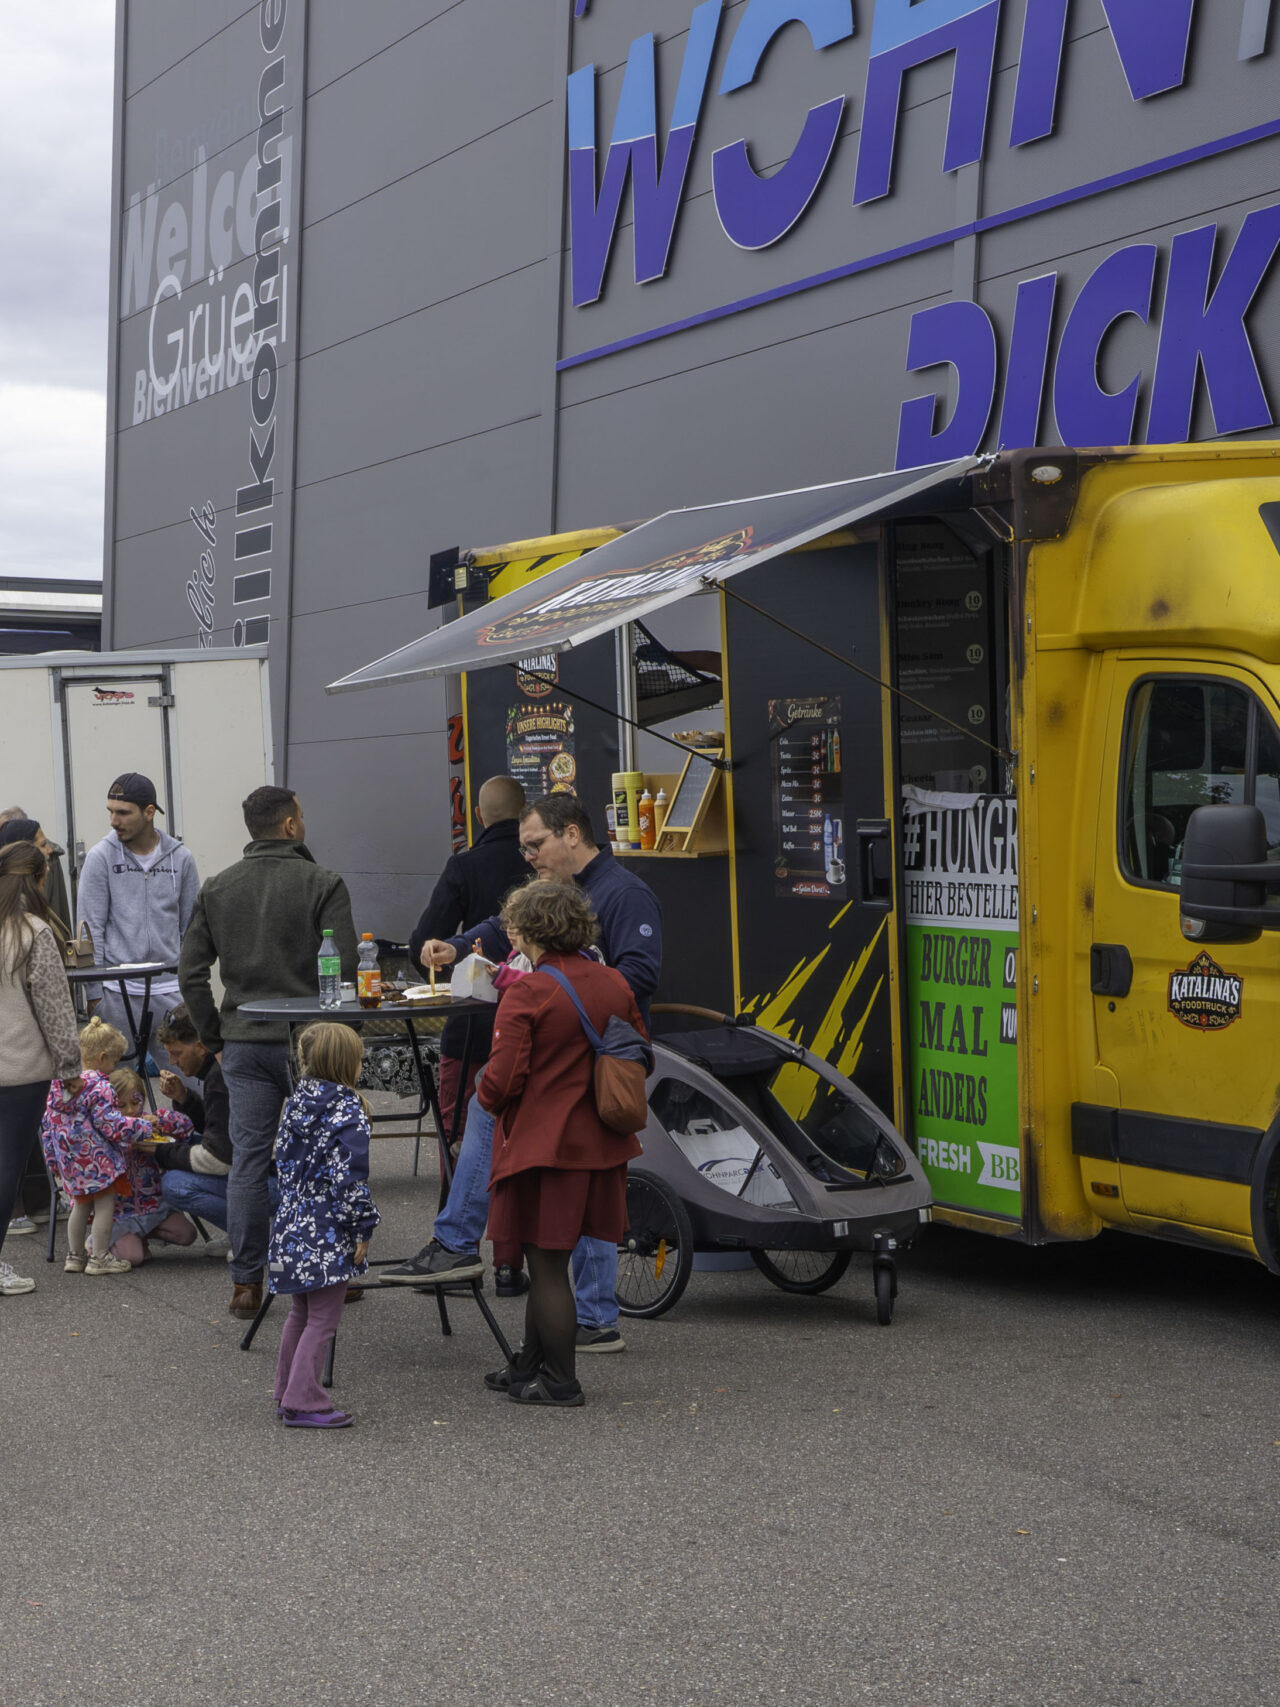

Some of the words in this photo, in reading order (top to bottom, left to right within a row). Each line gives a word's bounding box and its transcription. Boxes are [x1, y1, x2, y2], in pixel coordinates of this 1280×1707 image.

[229, 0, 287, 648] illkomme
[896, 202, 1280, 471] DICK
[968, 595, 980, 605] 10
[969, 648, 981, 658] 10
[517, 718, 536, 734] UNSERE
[537, 717, 567, 733] HIGHLIGHTS
[787, 704, 823, 723] Getränke
[970, 708, 983, 718] 10
[904, 798, 1018, 876] #HUNGR
[910, 880, 944, 915] HIER
[947, 881, 1018, 920] BESTELLE
[920, 933, 992, 988] BURGER
[1171, 975, 1240, 1005] KATALINA'S
[1181, 1001, 1227, 1013] FOODTRUCK
[919, 1000, 987, 1057] MAL
[918, 1068, 987, 1127] ANDERS
[917, 1136, 971, 1174] FRESH
[991, 1153, 1019, 1182] BB
[704, 1168, 744, 1180] OHNPARC
